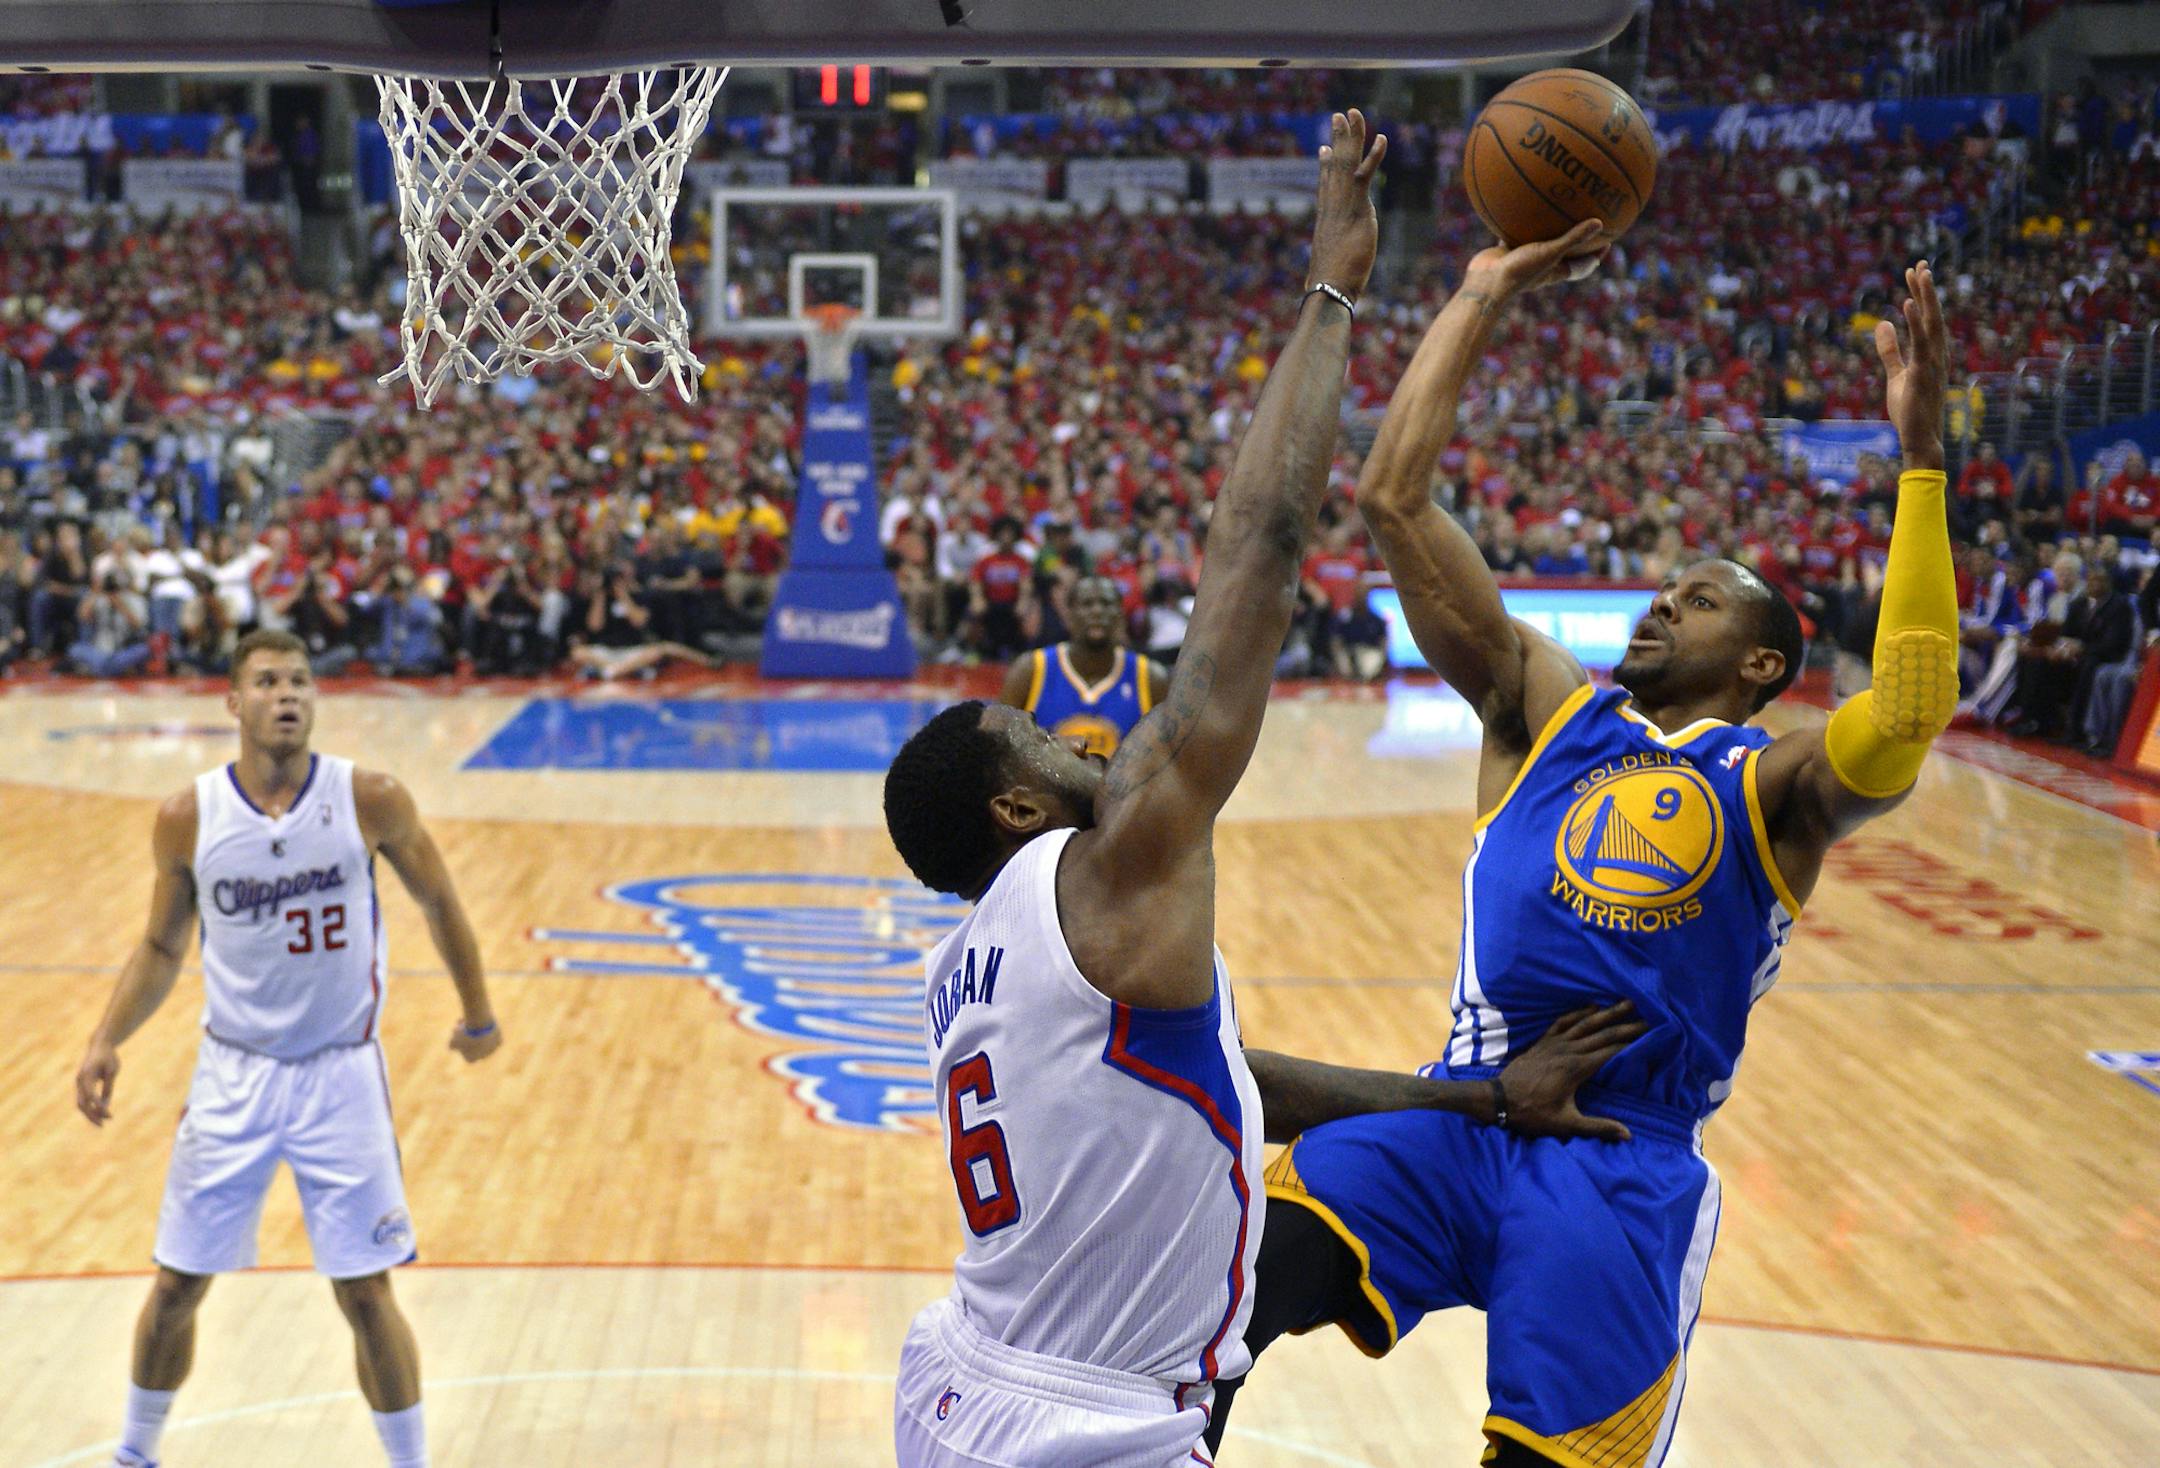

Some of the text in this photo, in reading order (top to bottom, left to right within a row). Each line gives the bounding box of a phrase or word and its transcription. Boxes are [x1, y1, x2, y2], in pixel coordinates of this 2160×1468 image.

[1574, 751, 1671, 794] GOLDEN
[1651, 787, 1683, 821] 9
[213, 864, 345, 924] Clippers
[1551, 871, 1703, 933] WARRIORS
[286, 904, 348, 954] 32
[948, 1051, 1021, 1237] 6
